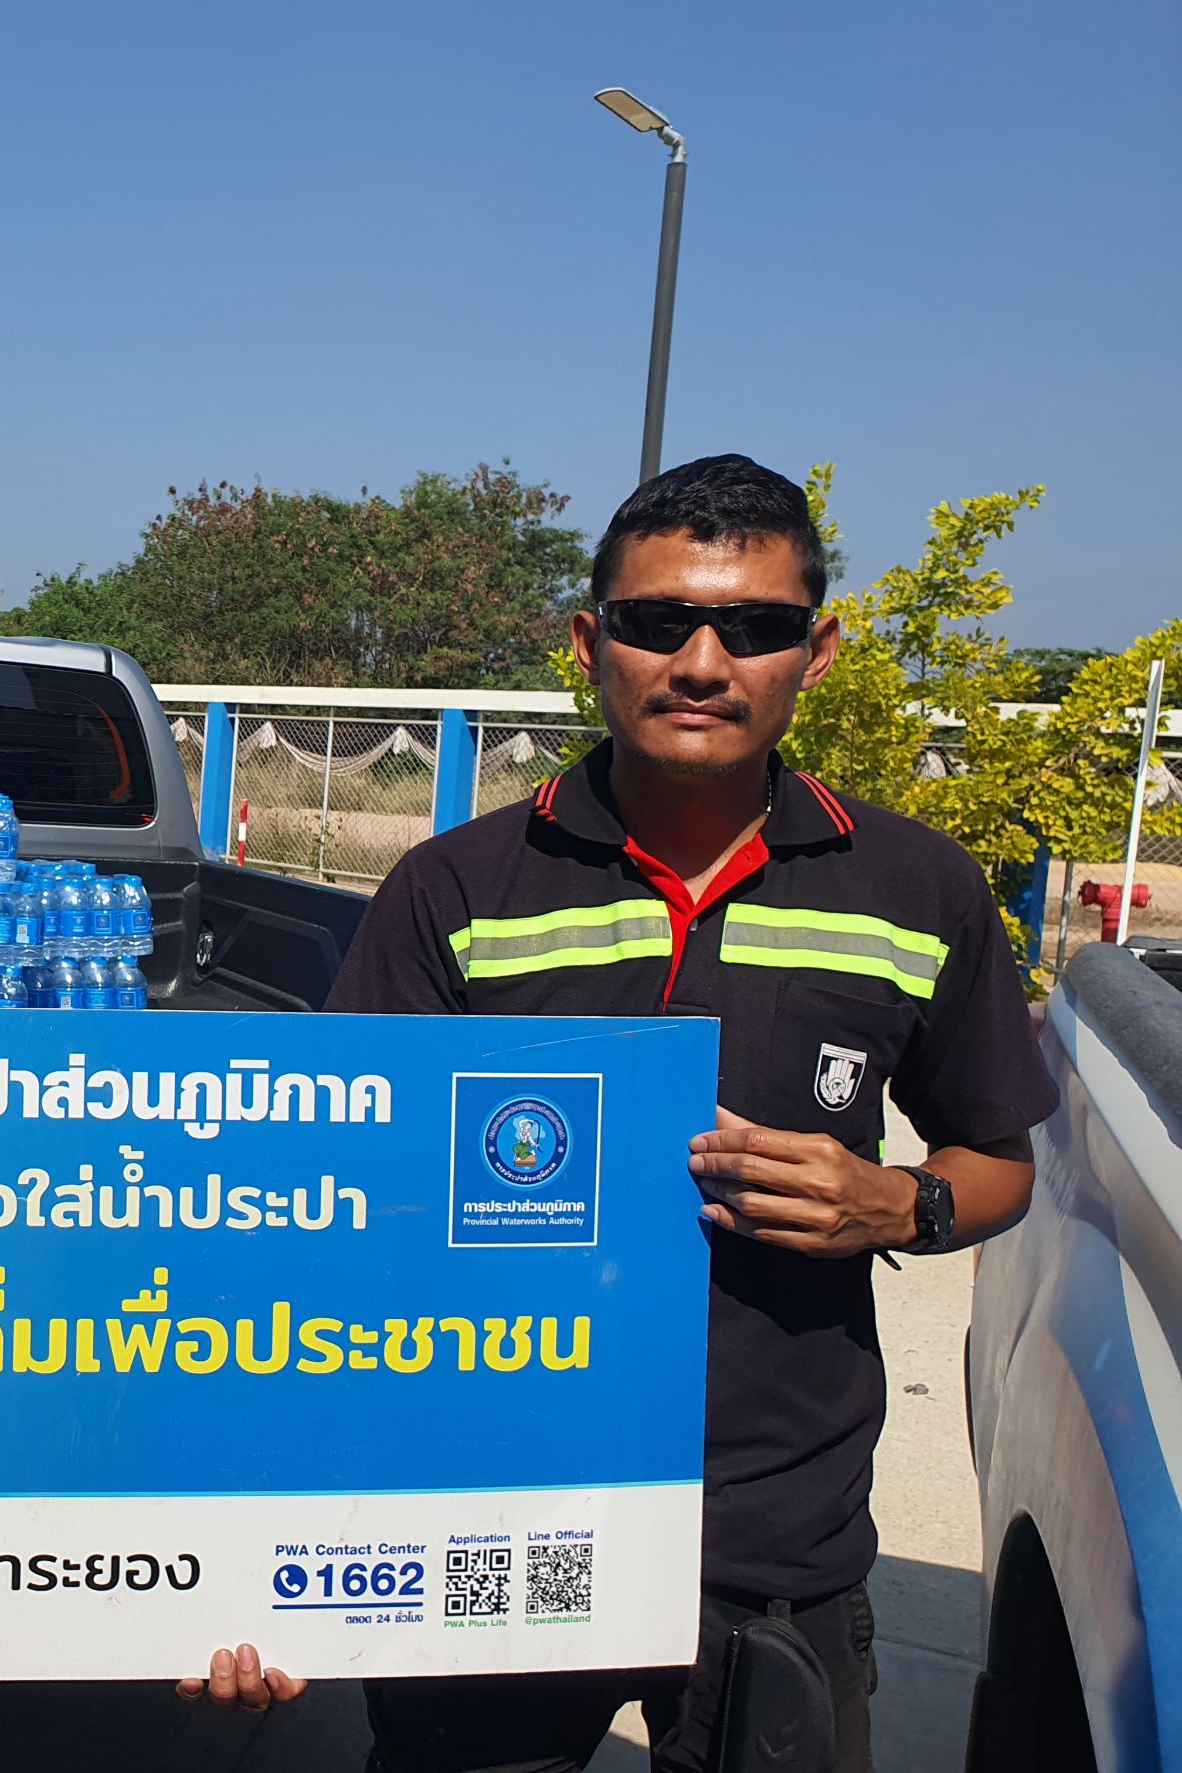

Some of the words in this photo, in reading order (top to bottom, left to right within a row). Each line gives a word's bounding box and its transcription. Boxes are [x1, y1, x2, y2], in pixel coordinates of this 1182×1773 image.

[463, 1199, 586, 1216] การประปาส่วนภูมิภาค
[463, 1216, 499, 1226] Provincial
[500, 1217, 547, 1226] Waterworks
[549, 1216, 585, 1227] Authority
[448, 1533, 511, 1546] Application
[527, 1530, 551, 1542] Line
[555, 1528, 594, 1541] Official
[275, 1544, 309, 1557] PWA
[315, 1543, 372, 1556] Contact
[378, 1542, 427, 1555] Center
[316, 1561, 425, 1598] 1662
[376, 1613, 391, 1624] 24
[443, 1620, 466, 1629] PWA
[468, 1619, 488, 1628] Plus
[490, 1618, 508, 1628] Life
[524, 1614, 592, 1626] @pwathailand
